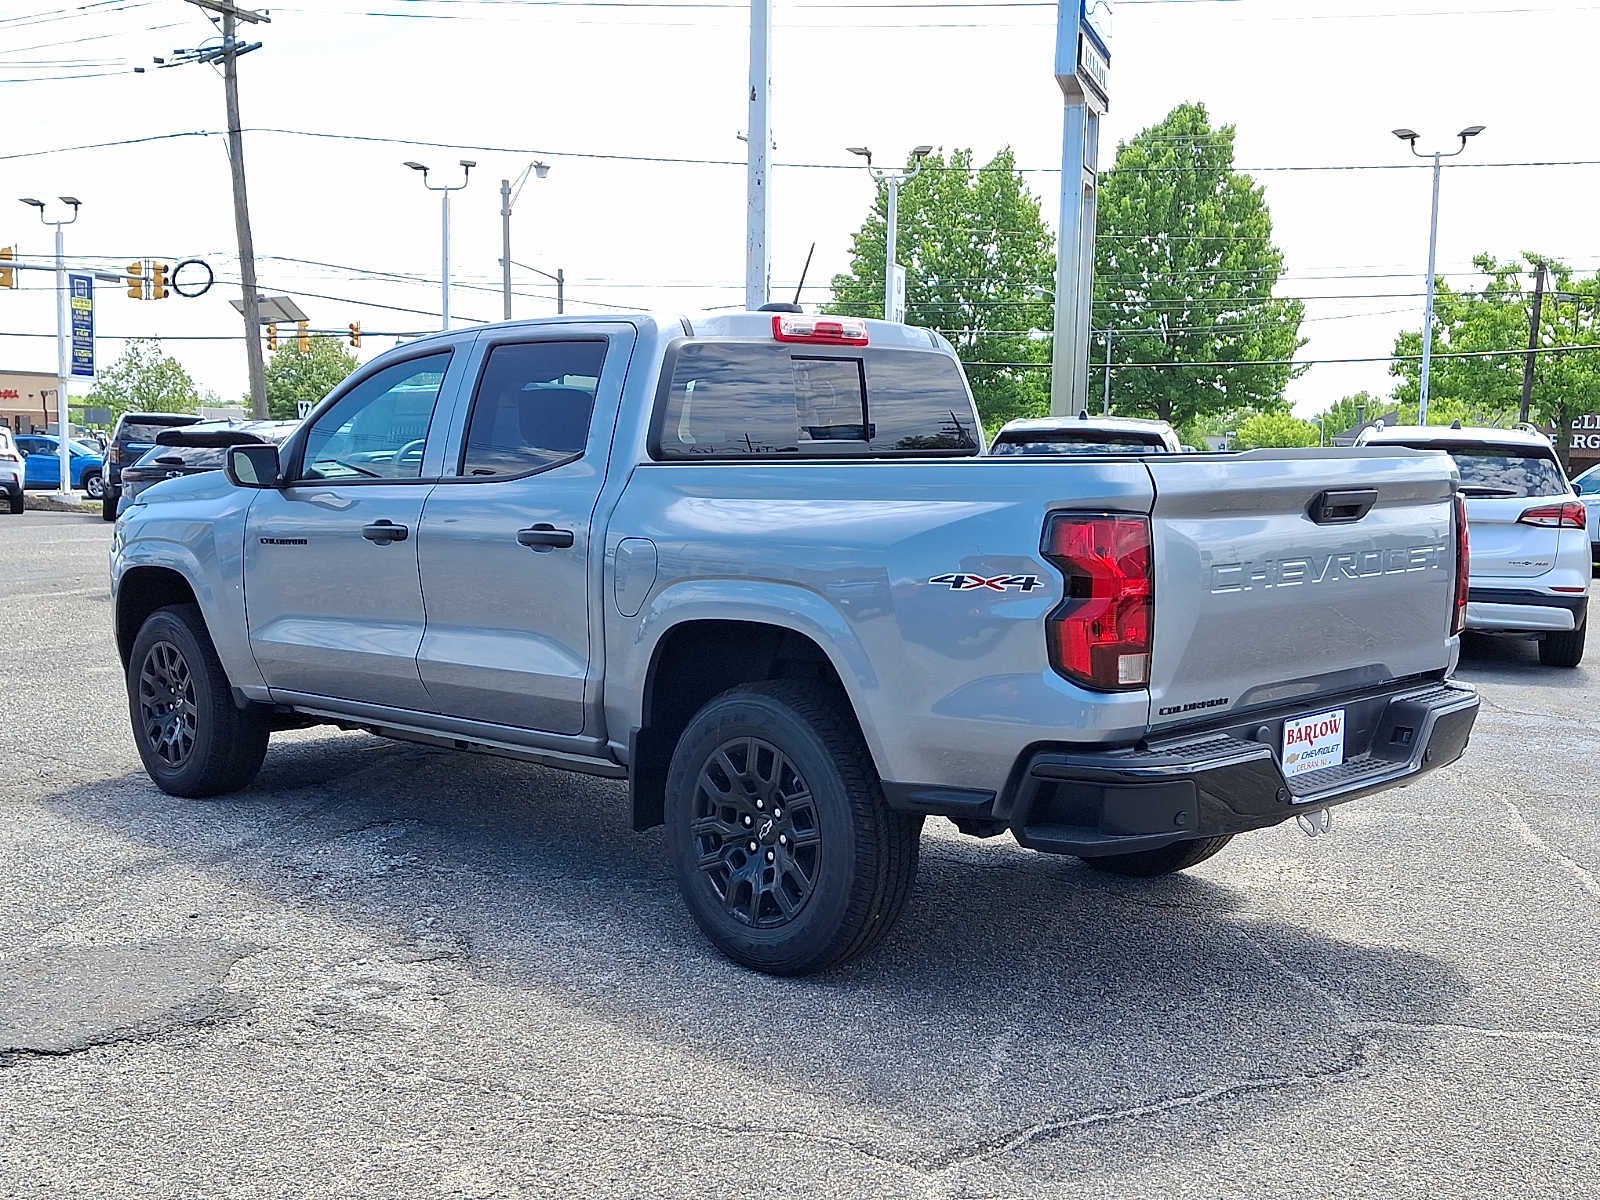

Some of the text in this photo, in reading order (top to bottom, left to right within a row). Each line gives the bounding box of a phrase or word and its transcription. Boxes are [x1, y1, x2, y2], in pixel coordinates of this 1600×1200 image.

[1548, 433, 1600, 449] FRG
[1211, 543, 1446, 594] CHEVROLET
[1286, 717, 1341, 747] BARLOW
[1301, 743, 1341, 760] CHEVROLET
